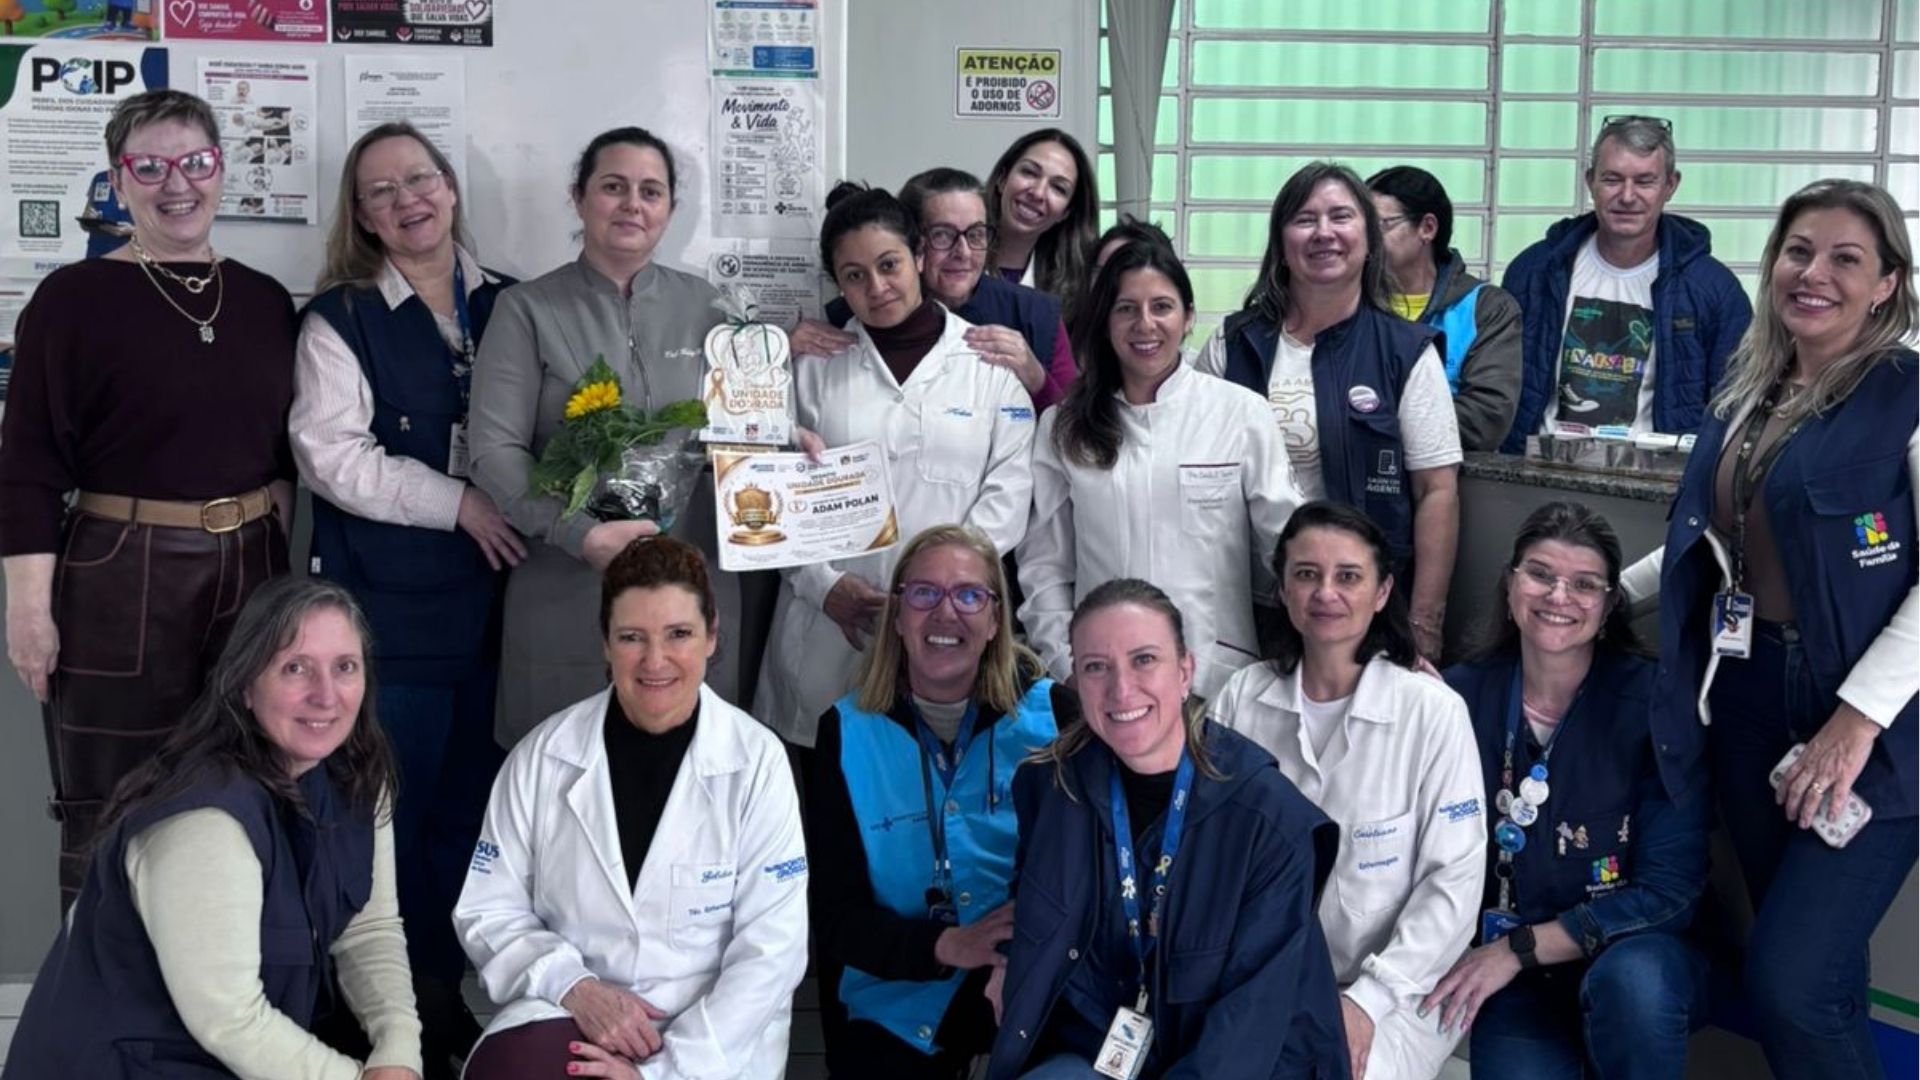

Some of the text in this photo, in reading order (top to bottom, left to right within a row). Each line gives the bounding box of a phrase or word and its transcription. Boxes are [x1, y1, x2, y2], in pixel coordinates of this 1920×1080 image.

[964, 53, 1055, 74] ATENÇÃO
[965, 75, 1028, 89] É PROIBIDO
[971, 89, 1020, 100] O USO DE
[722, 98, 791, 114] Movimento
[971, 101, 1021, 112] ADORNOS
[731, 114, 778, 131] & Vida
[731, 389, 785, 400] UNIDADE
[812, 493, 880, 515] ADAM POLAN
[477, 839, 500, 859] SUS
